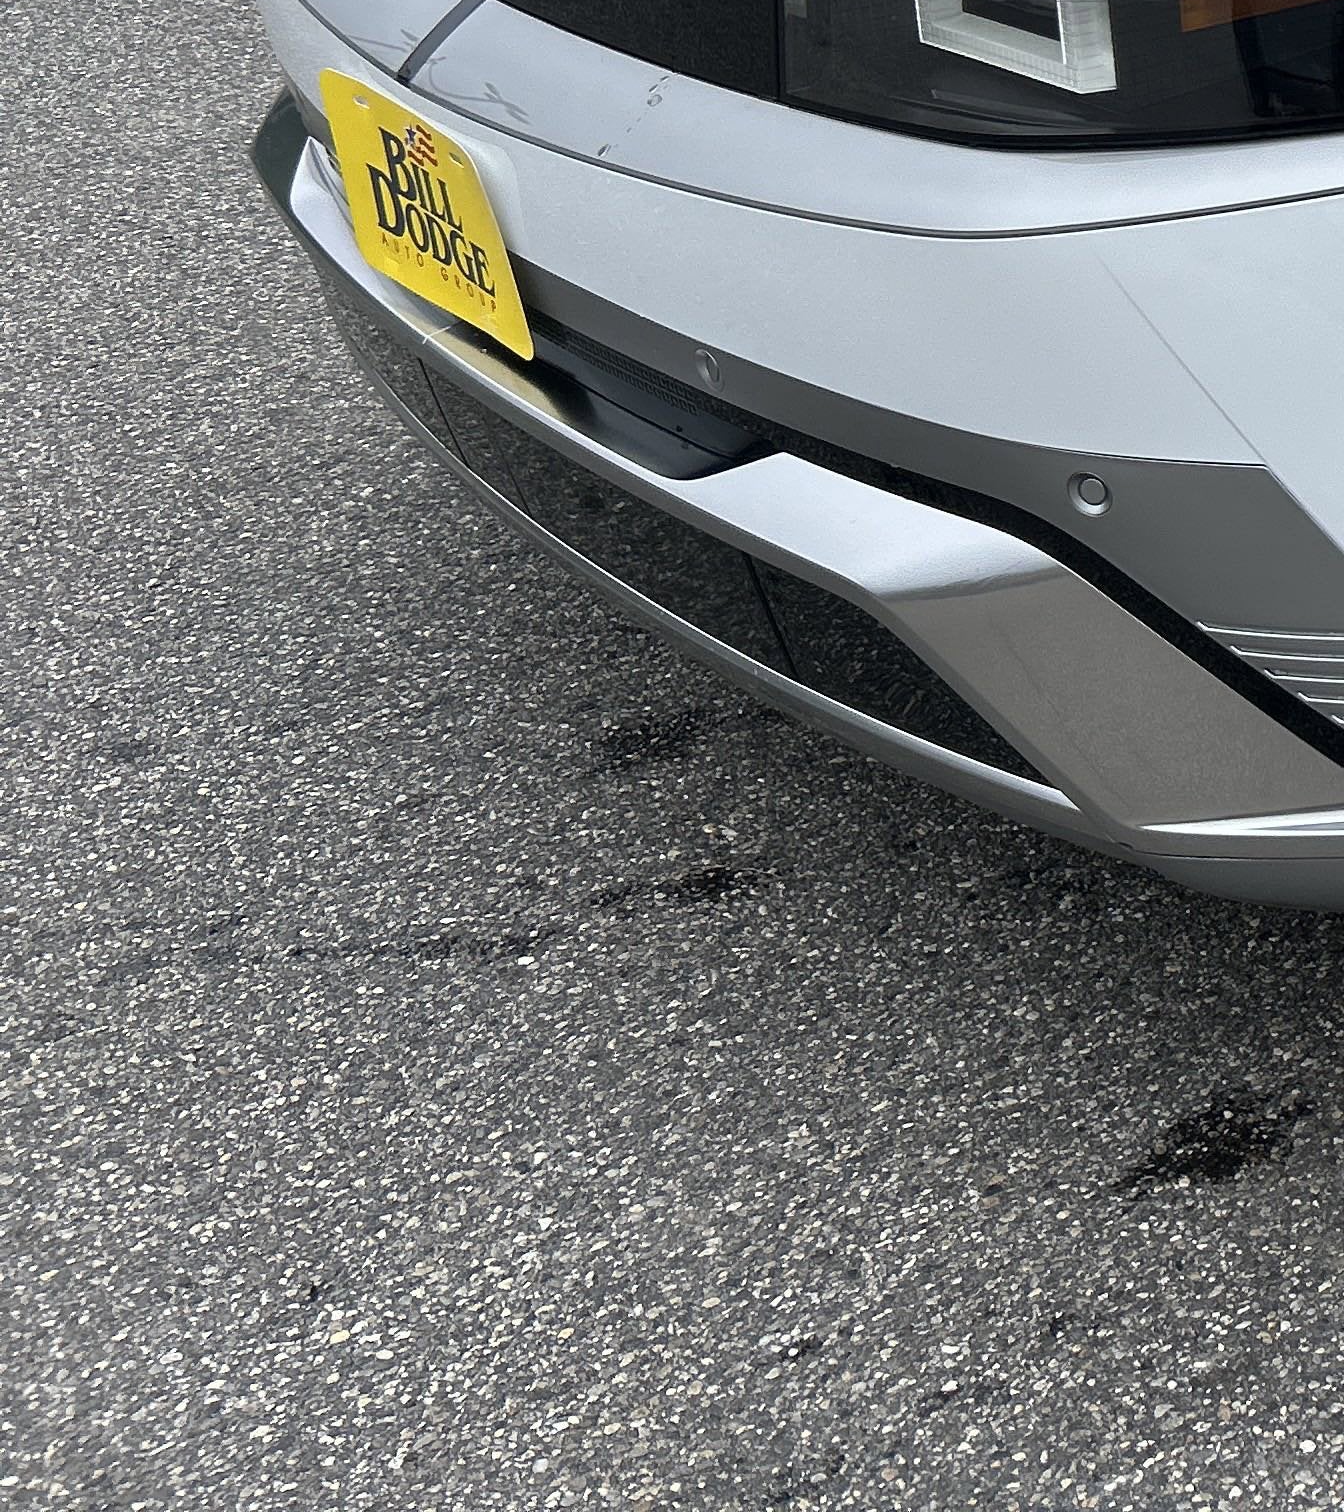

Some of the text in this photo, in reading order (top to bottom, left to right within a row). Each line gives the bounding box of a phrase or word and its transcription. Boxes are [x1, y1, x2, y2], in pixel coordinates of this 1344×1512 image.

[366, 162, 496, 298] DODGE
[378, 127, 464, 233] BILL
[381, 233, 498, 312] AUTO GROUP
